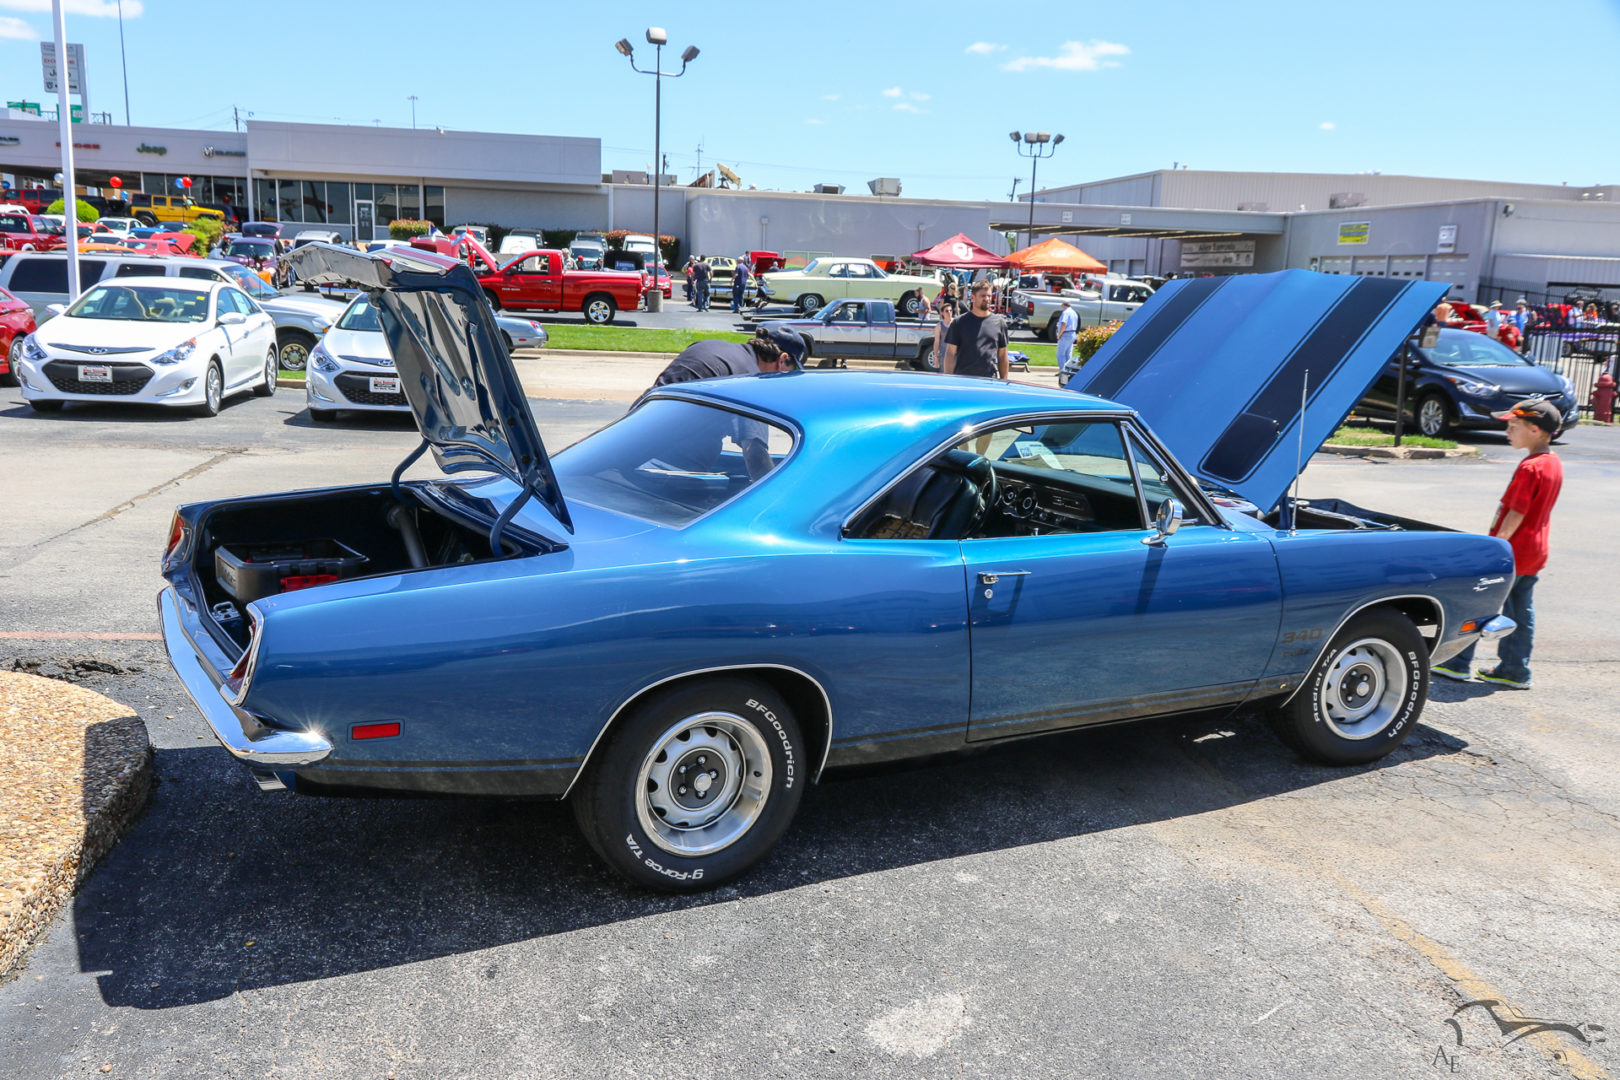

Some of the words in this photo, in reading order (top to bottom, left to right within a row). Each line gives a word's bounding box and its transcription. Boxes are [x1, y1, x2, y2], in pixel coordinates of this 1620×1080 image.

[1281, 627, 1323, 644] 340
[1388, 651, 1421, 738] BFGoodrich
[745, 698, 795, 789] BFGoodrich
